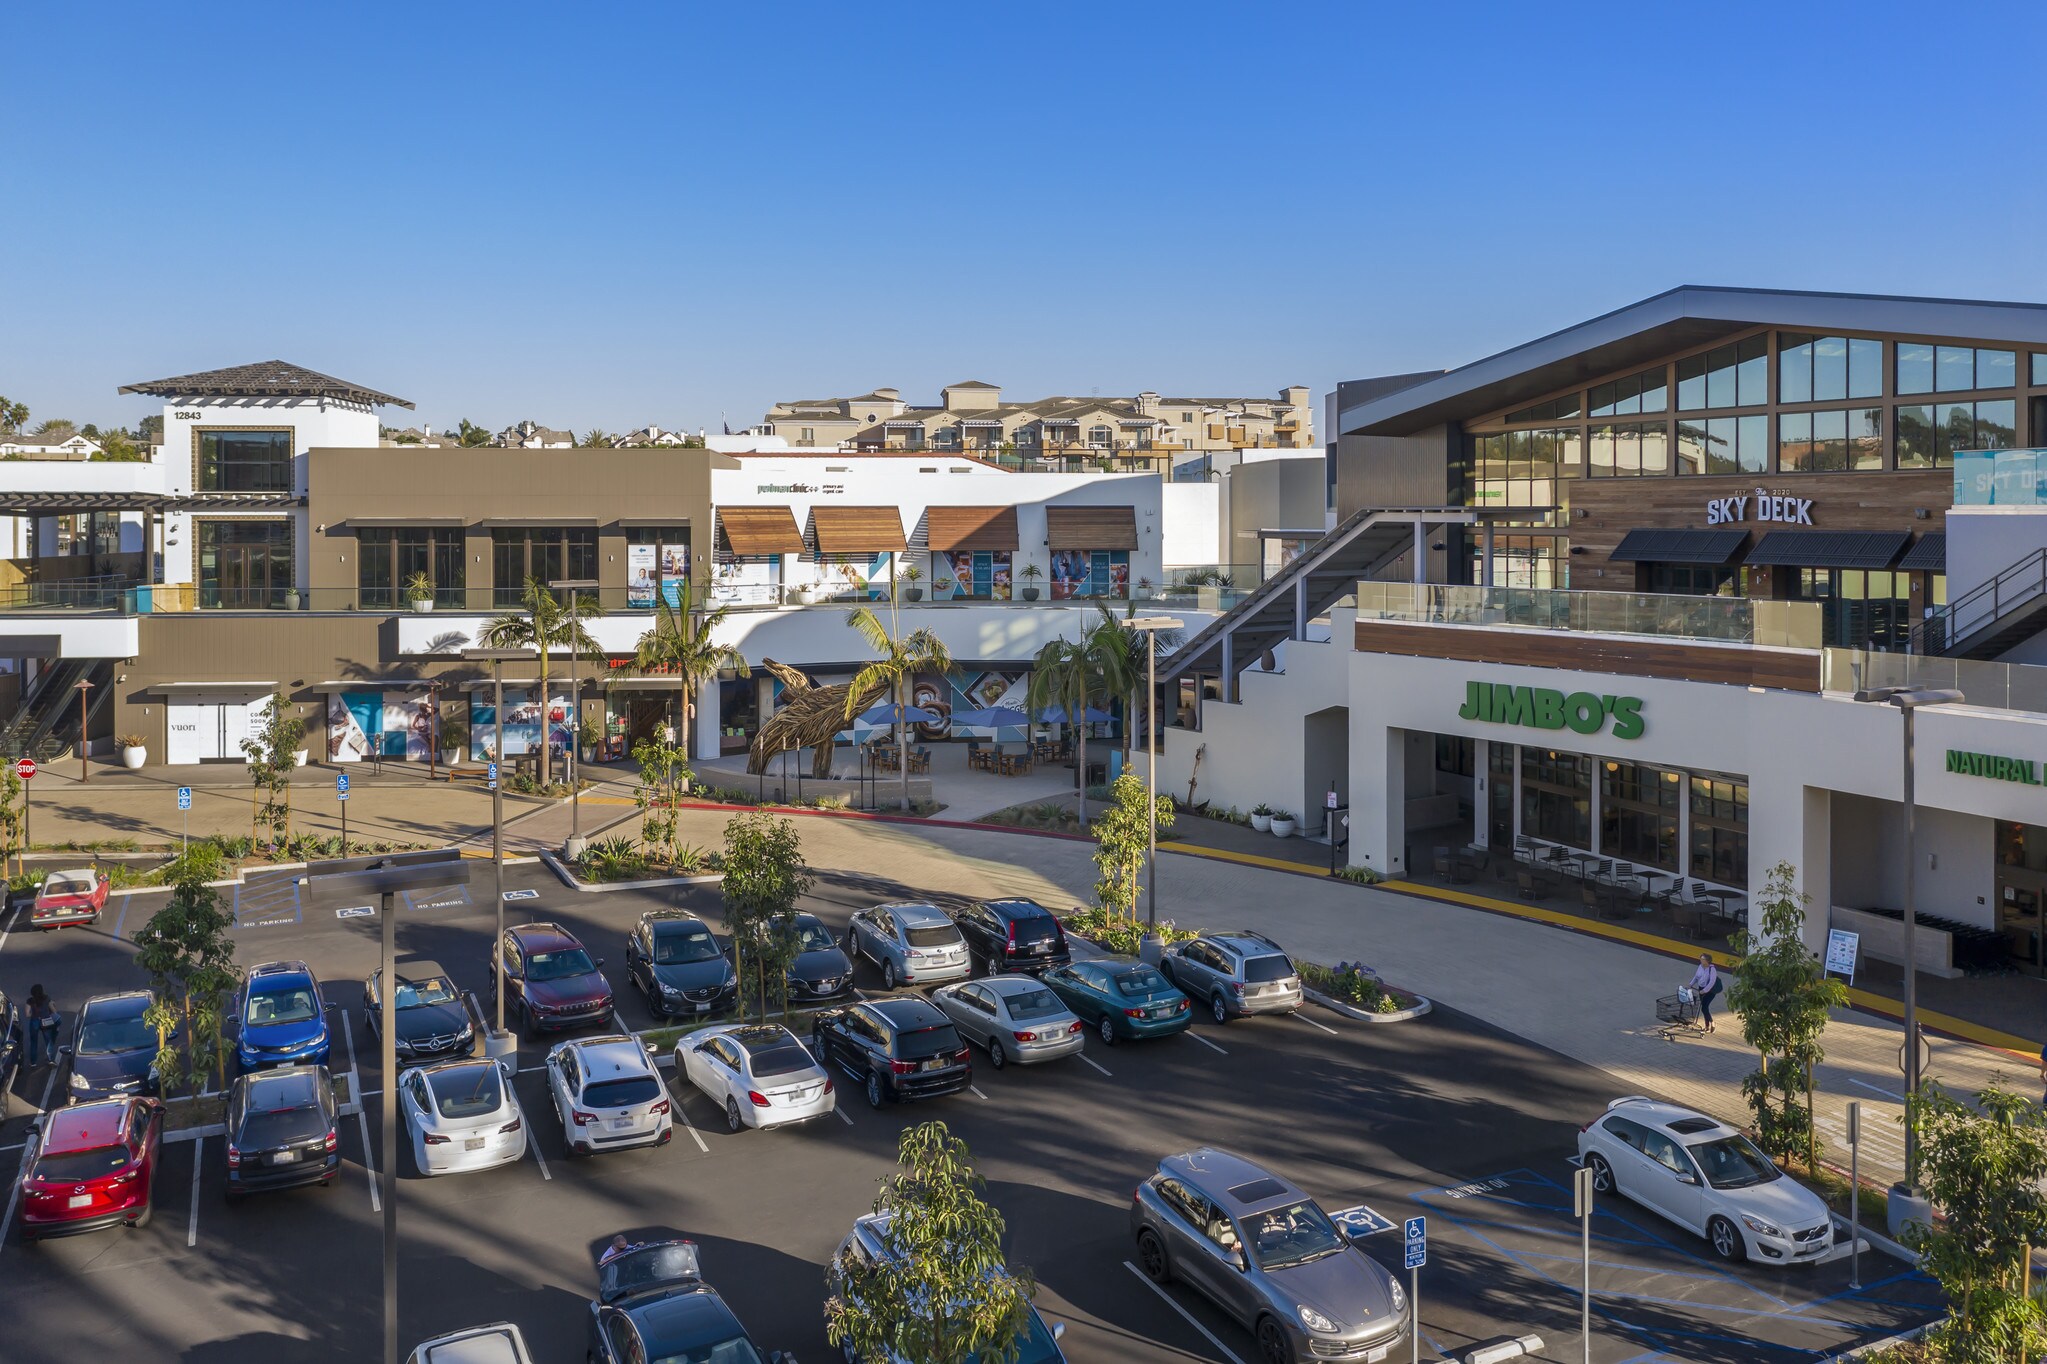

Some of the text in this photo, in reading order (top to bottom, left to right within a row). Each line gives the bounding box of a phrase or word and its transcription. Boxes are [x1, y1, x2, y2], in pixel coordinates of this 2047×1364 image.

[174, 411, 202, 420] 12843
[1707, 496, 1812, 526] SKY DECK
[1458, 681, 1645, 740] JIMBO'S
[17, 765, 36, 773] STOP
[1946, 749, 2041, 785] NATURAL
